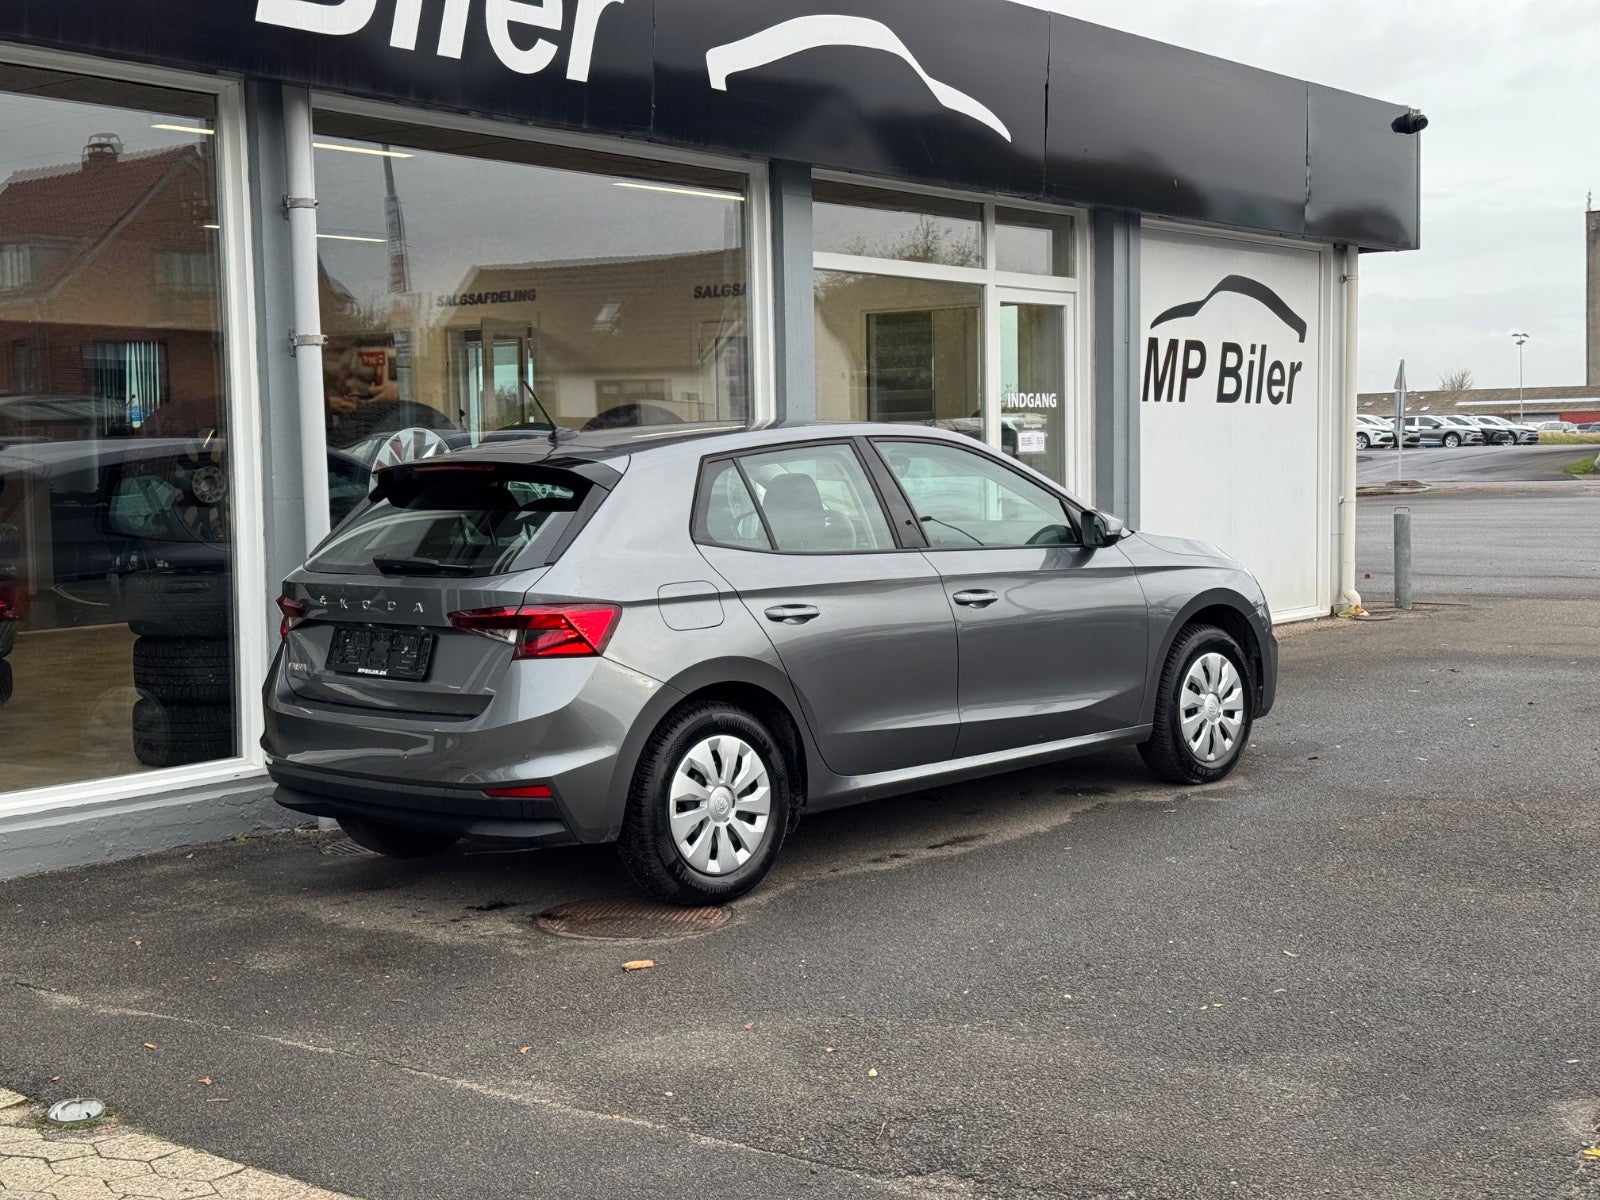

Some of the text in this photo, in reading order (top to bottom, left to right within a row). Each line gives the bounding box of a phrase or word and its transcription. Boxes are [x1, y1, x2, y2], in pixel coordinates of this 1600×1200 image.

[437, 288, 537, 307] SALGSAFDELING
[1142, 337, 1302, 405] MP Biler
[1007, 392, 1057, 408] INDGANG
